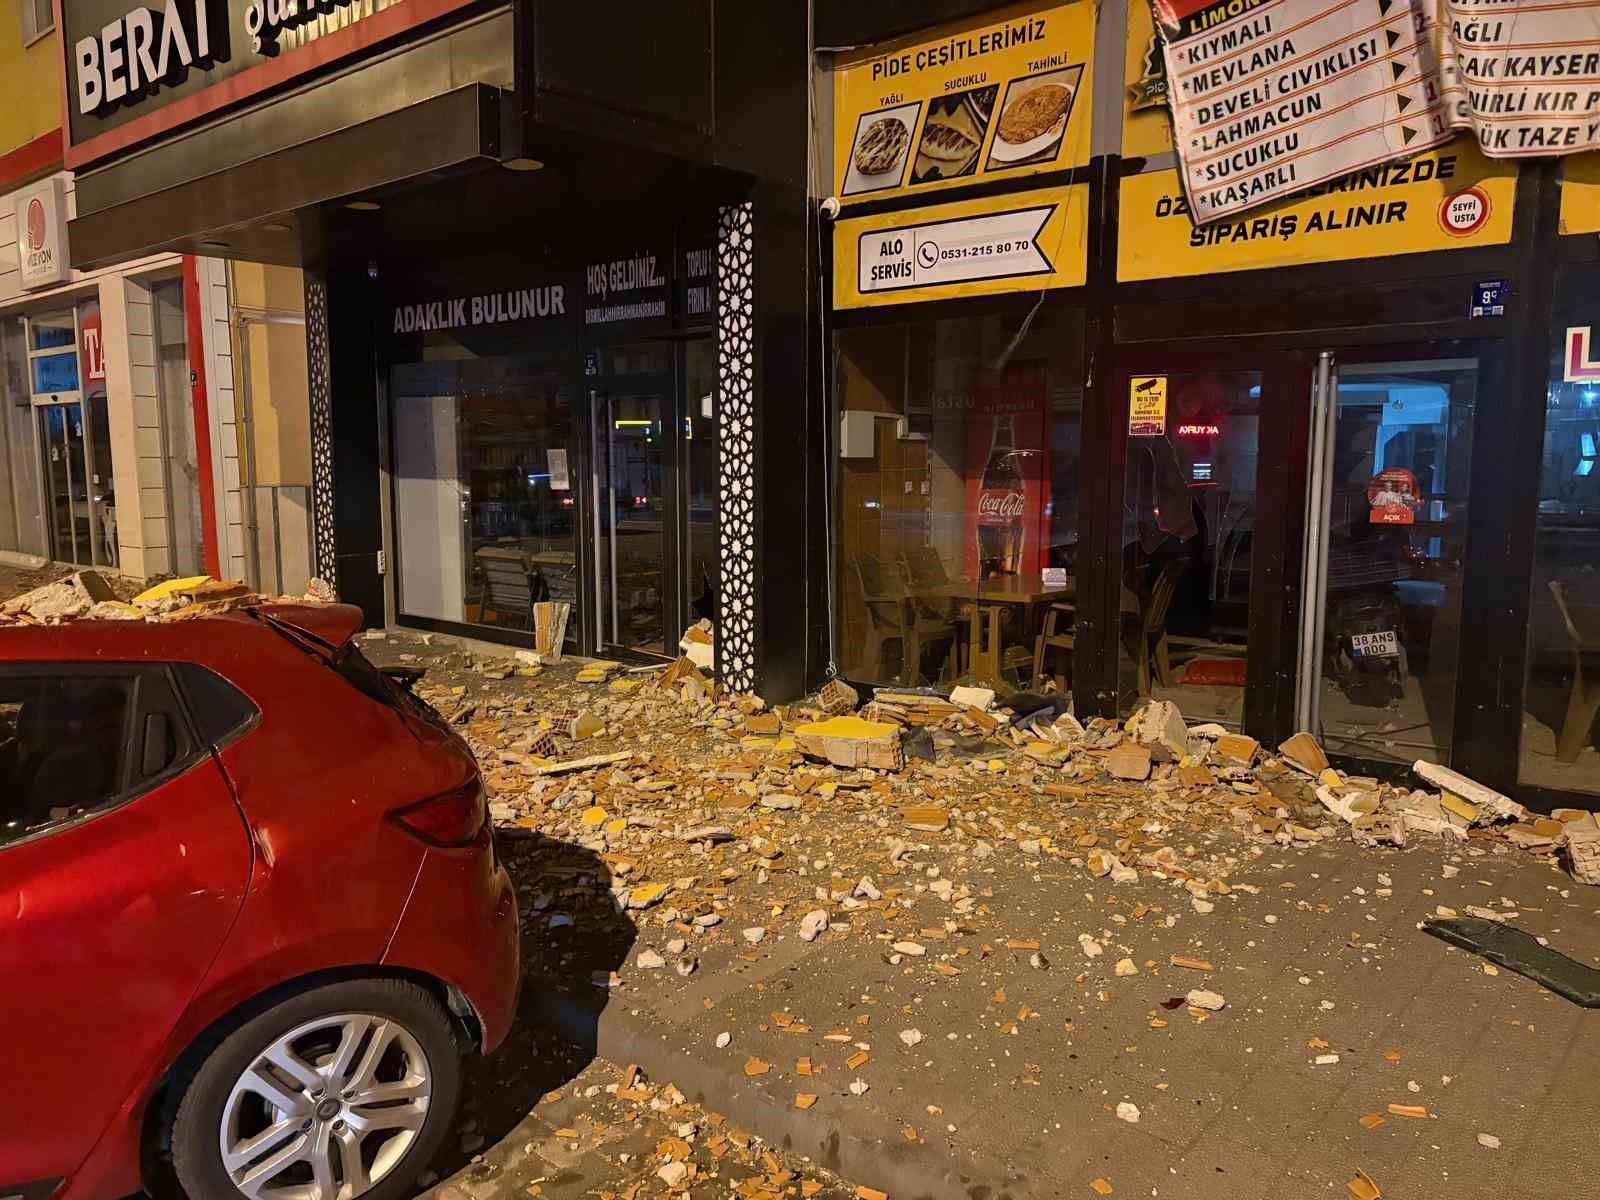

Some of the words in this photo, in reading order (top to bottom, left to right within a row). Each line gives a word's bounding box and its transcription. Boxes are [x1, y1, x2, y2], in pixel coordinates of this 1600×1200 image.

[872, 55, 911, 81] PİDE
[915, 19, 1046, 71] ÇEŞİTLERİMİZ
[1188, 15, 1273, 65] KIYMALI
[1027, 51, 1068, 72] TAHİNLİ
[1192, 39, 1296, 94] MEVLANA
[944, 72, 987, 92] SUCUKLU
[1198, 79, 1272, 125] DEVELİ
[1277, 38, 1378, 94] CIVIKLISI
[879, 94, 904, 107] YAĞLI
[1533, 92, 1578, 111] KIR
[1202, 92, 1322, 151] LAHMACUN
[1517, 127, 1580, 147] TAZE
[1206, 133, 1299, 181] SUCUKLU
[1210, 163, 1297, 209] KAŞARLI
[1305, 201, 1408, 233] ALINIR
[1453, 200, 1476, 212] SEYFİ
[1455, 213, 1476, 223] USTA
[879, 239, 904, 257] ALO
[941, 246, 993, 260] 0531-215
[996, 243, 1012, 254] 80
[1014, 240, 1029, 251] 70
[871, 259, 912, 281] SERVİS
[586, 264, 608, 301] HOŞ
[393, 297, 468, 334] ADAKLIK
[471, 285, 566, 326] BULUNUR
[1353, 635, 1369, 647] 38
[1371, 632, 1394, 644] ANS
